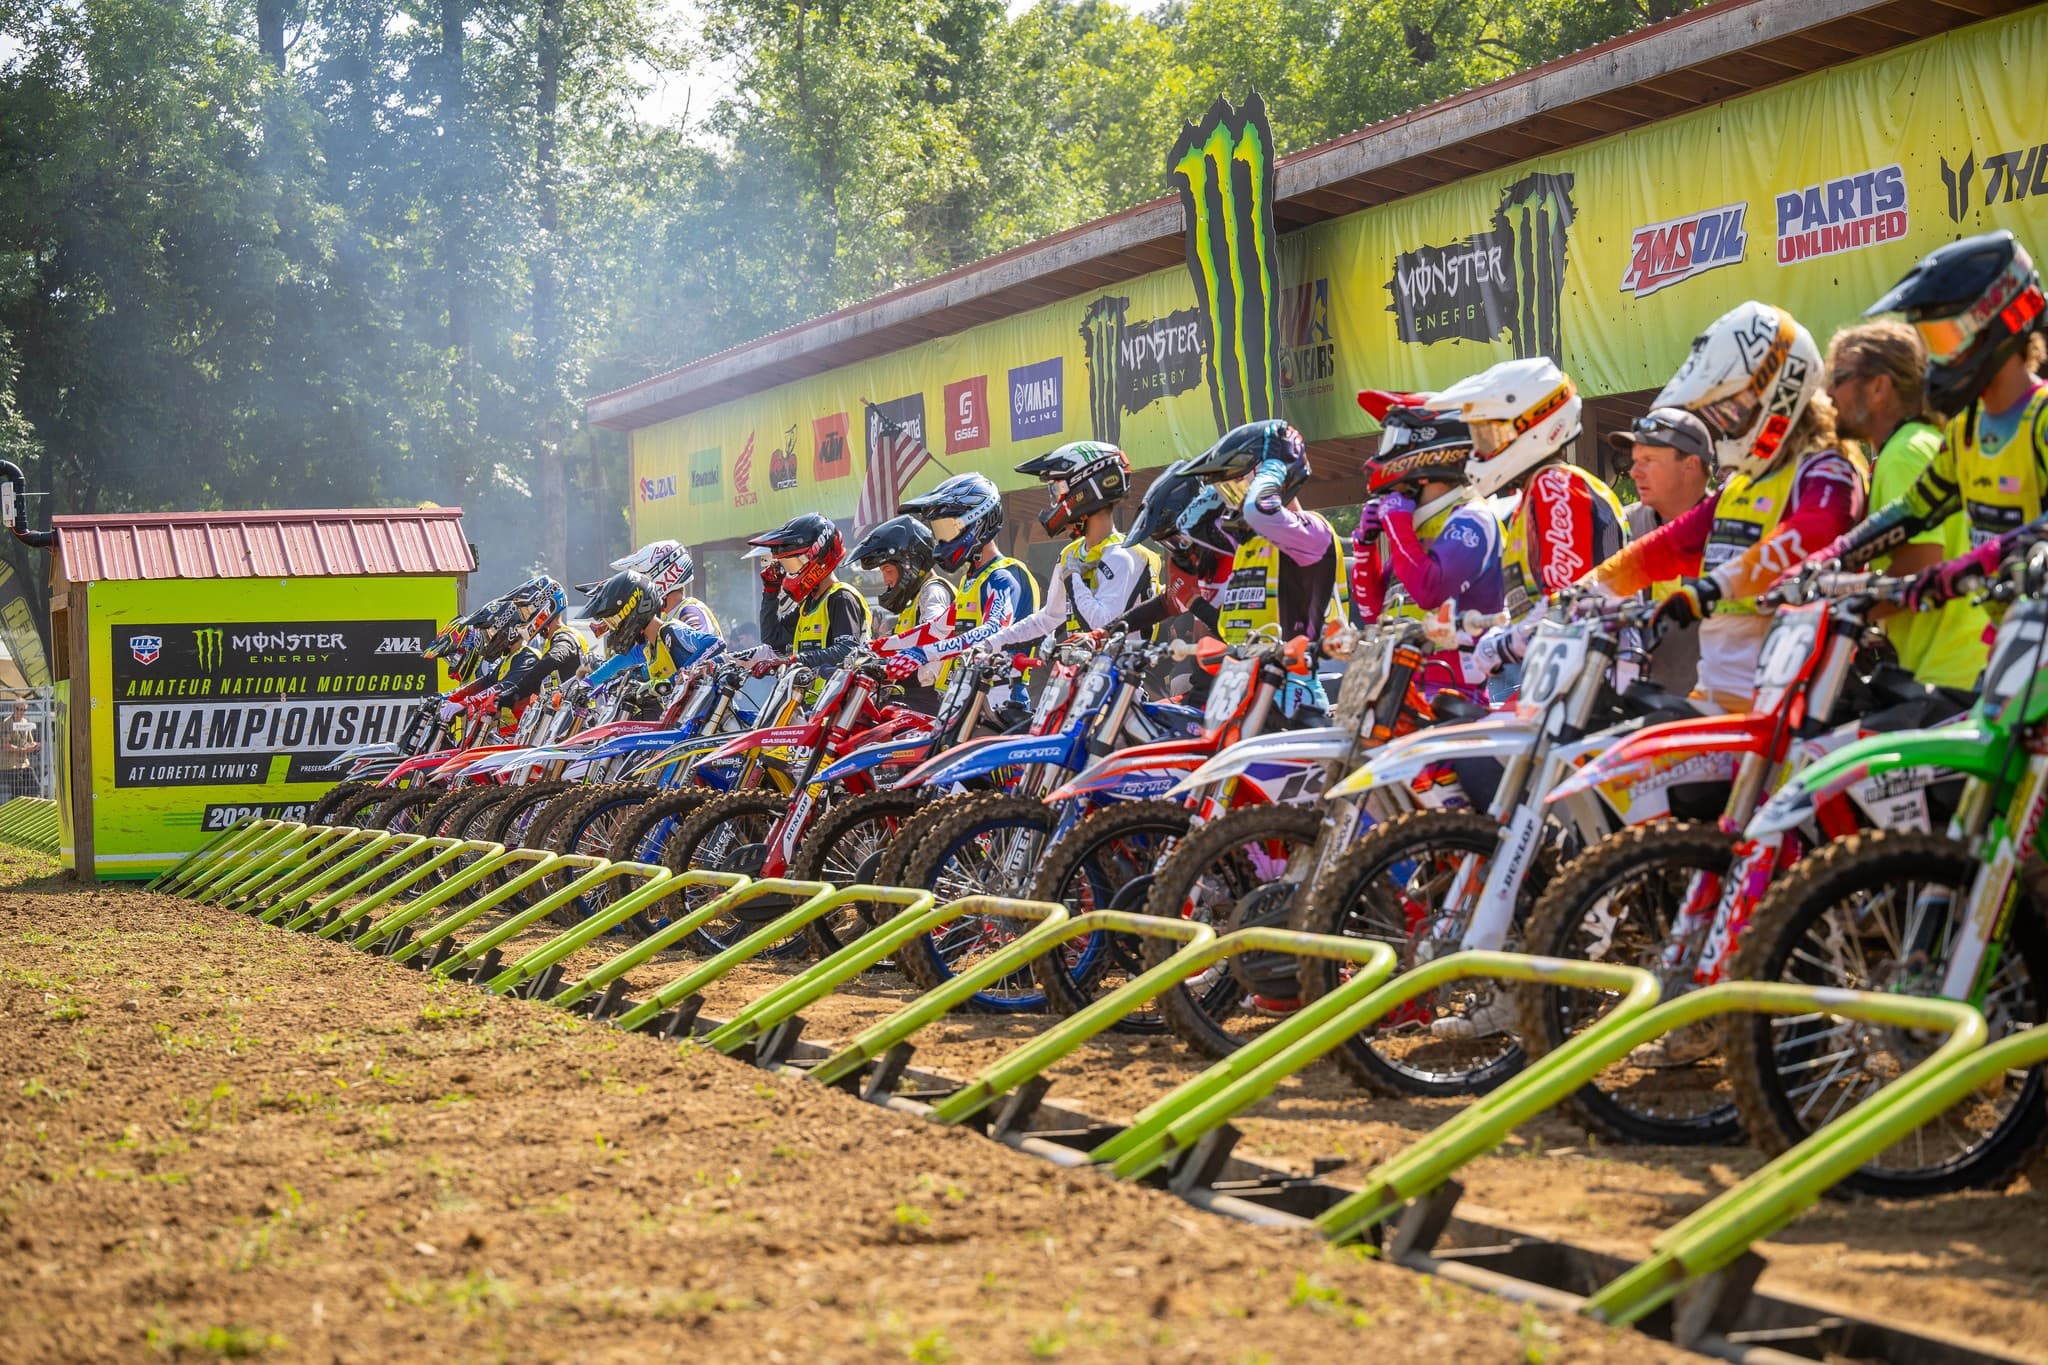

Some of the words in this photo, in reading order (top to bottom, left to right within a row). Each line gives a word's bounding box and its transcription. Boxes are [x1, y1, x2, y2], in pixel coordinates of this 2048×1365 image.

[1777, 166, 1906, 236] PARTS
[1623, 204, 1747, 297] AMSOIL
[1777, 210, 1907, 265] UNLIMITED
[1399, 246, 1506, 306] MONSTER
[1415, 299, 1487, 332] ENERGY
[1120, 321, 1201, 369] MONSTER
[619, 587, 644, 620] 100%
[232, 631, 347, 653] MONSTER
[250, 655, 329, 663] ENERGY
[374, 637, 424, 654] AMA
[126, 678, 211, 697] AMATEUR
[220, 676, 307, 695] NATIONAL
[317, 674, 426, 693] MOTOCROSS
[126, 704, 419, 752] CHAMPIONSHI
[128, 766, 147, 781] AT
[149, 764, 206, 780] LORETTA
[211, 763, 258, 779] LYNN'S
[786, 797, 808, 841] DUNLOP
[1504, 819, 1535, 888] DUNLOP
